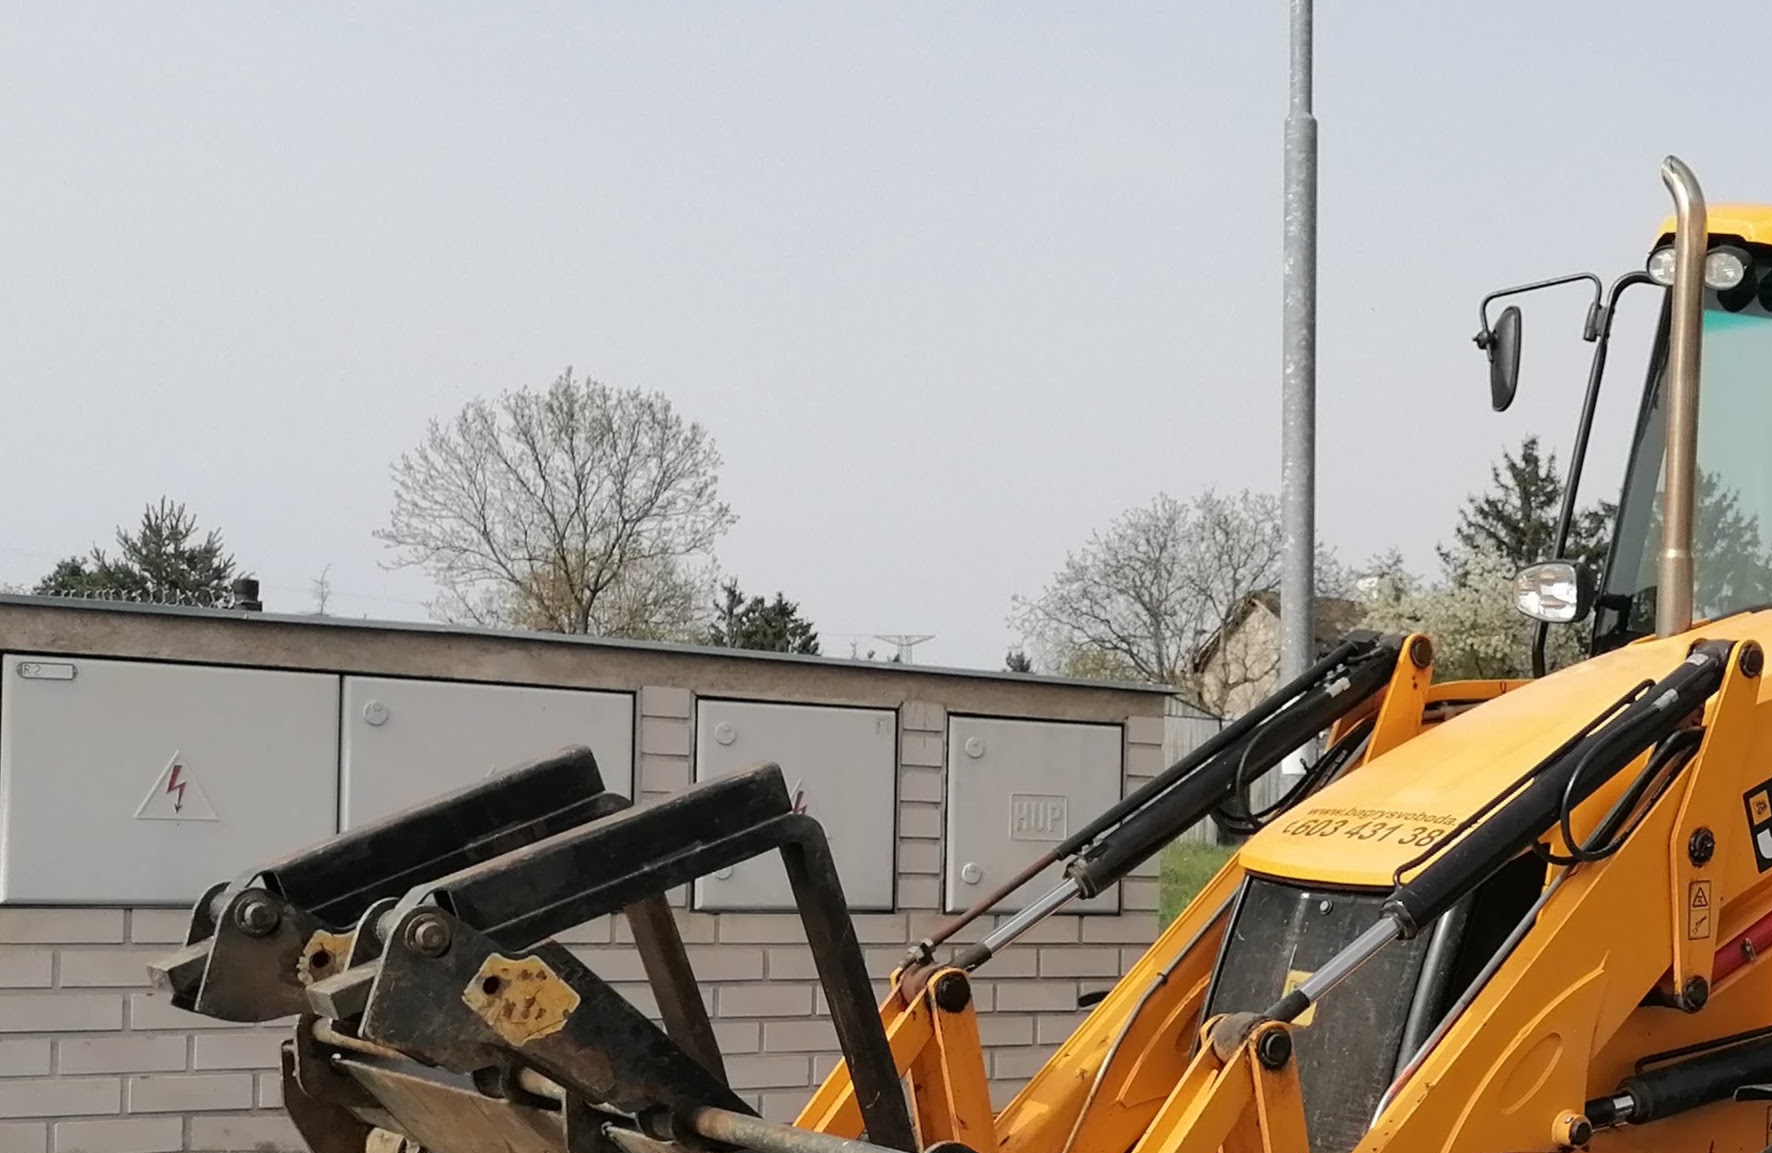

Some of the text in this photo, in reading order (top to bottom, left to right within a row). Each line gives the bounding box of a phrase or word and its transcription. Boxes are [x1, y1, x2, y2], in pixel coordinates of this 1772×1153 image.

[1014, 801, 1063, 832] HUP
[1308, 807, 1457, 827] www.bagrysvoboda.
[1291, 818, 1446, 847] 603 431 38
